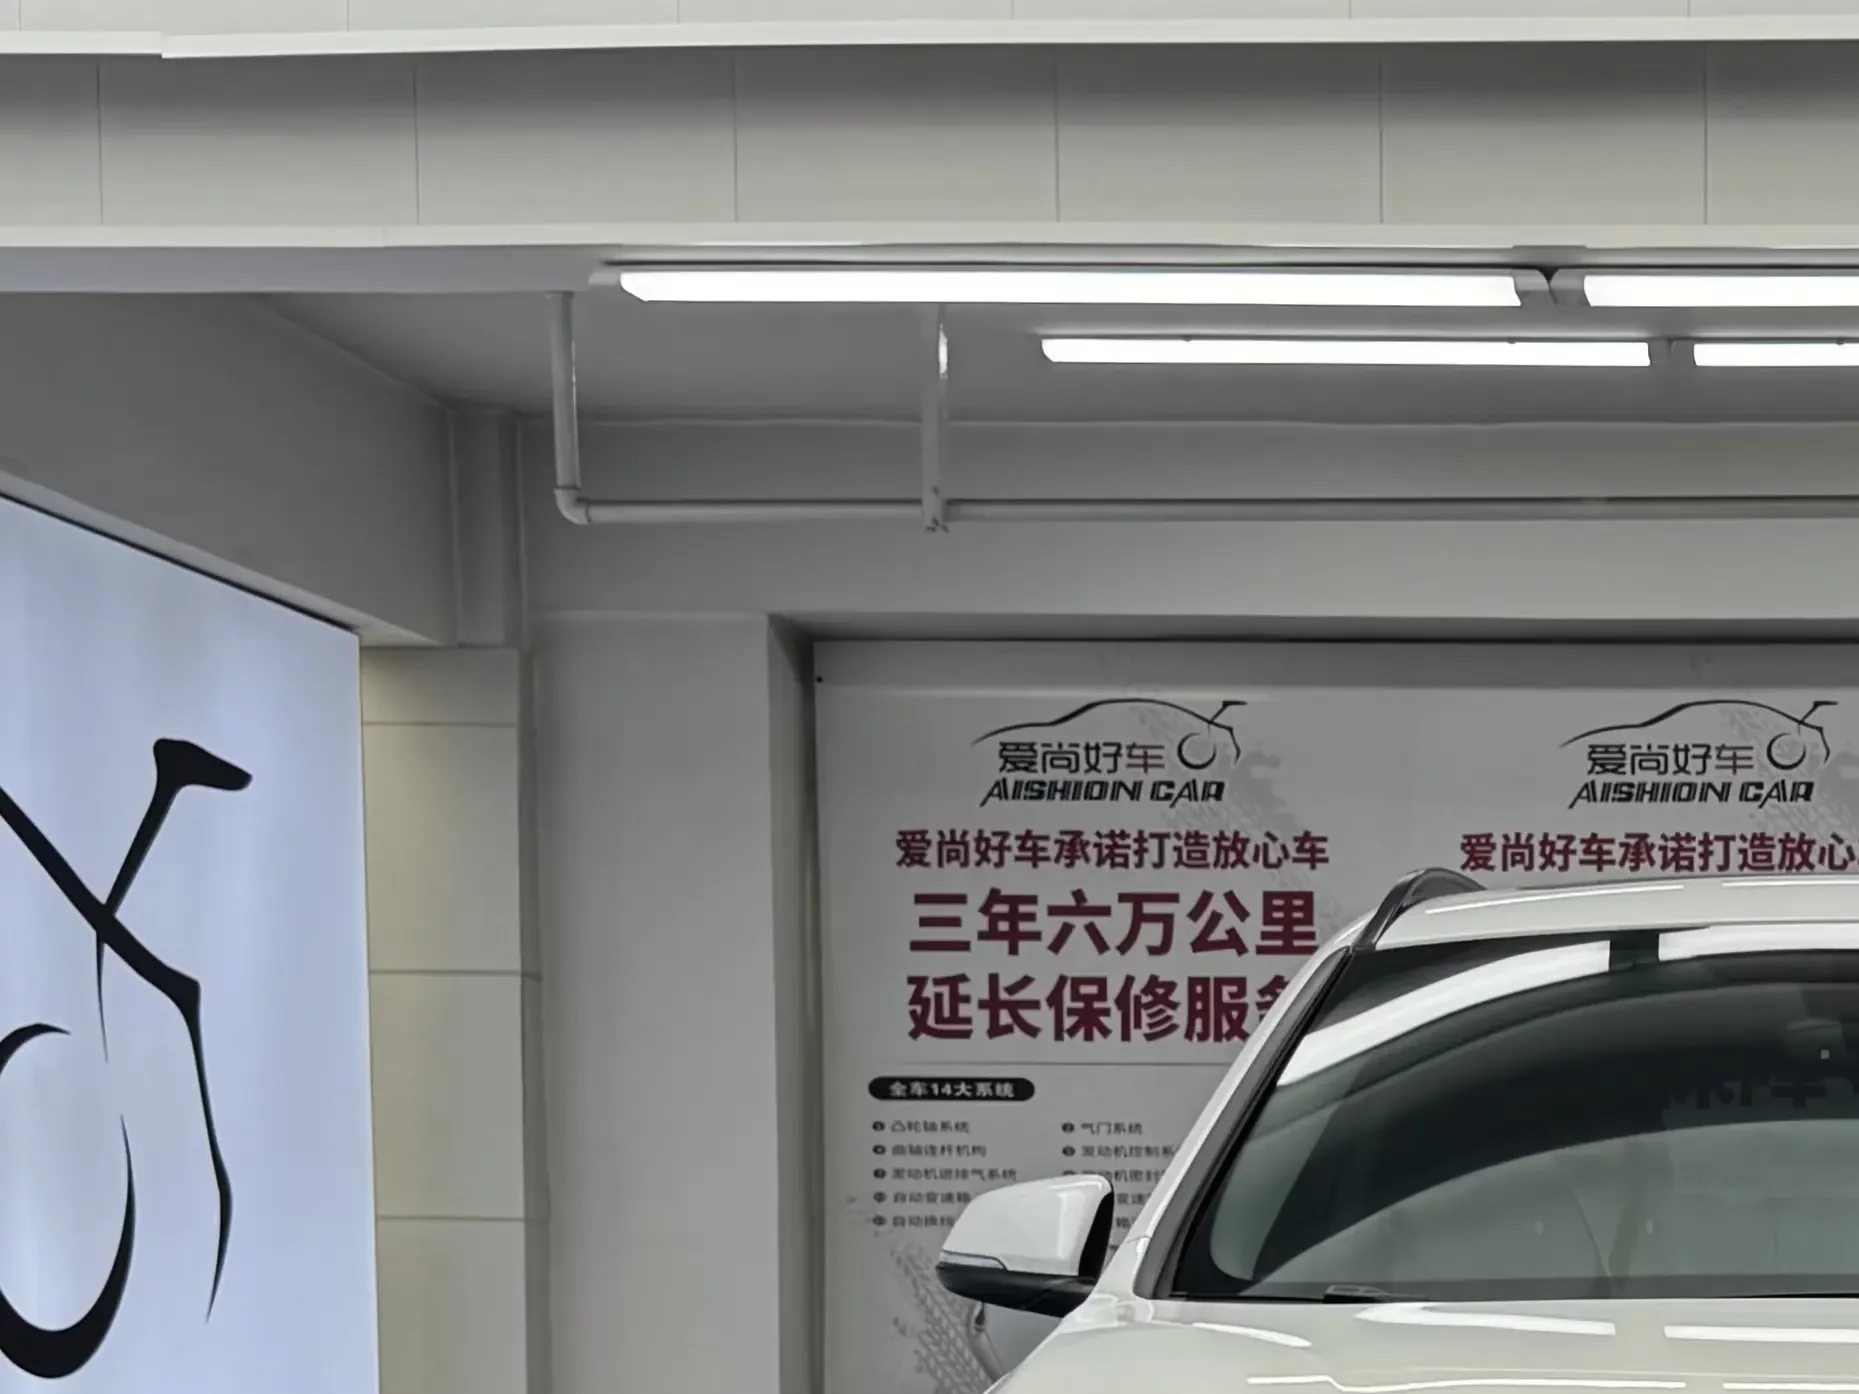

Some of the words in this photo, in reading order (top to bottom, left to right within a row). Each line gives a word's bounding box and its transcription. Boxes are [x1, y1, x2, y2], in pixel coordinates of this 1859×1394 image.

[998, 741, 1166, 775] 爱尚好车
[1587, 743, 1754, 776] 爱尚好车
[979, 777, 1143, 808] AISHION
[1149, 779, 1226, 809] CAR
[1568, 779, 1732, 809] AISHION
[1738, 779, 1814, 809] CAR
[895, 828, 1330, 871] 爱尚好车承诺打造放心车
[908, 887, 1320, 957] 三年六万公里
[889, 1081, 1016, 1098] 全车14大系统
